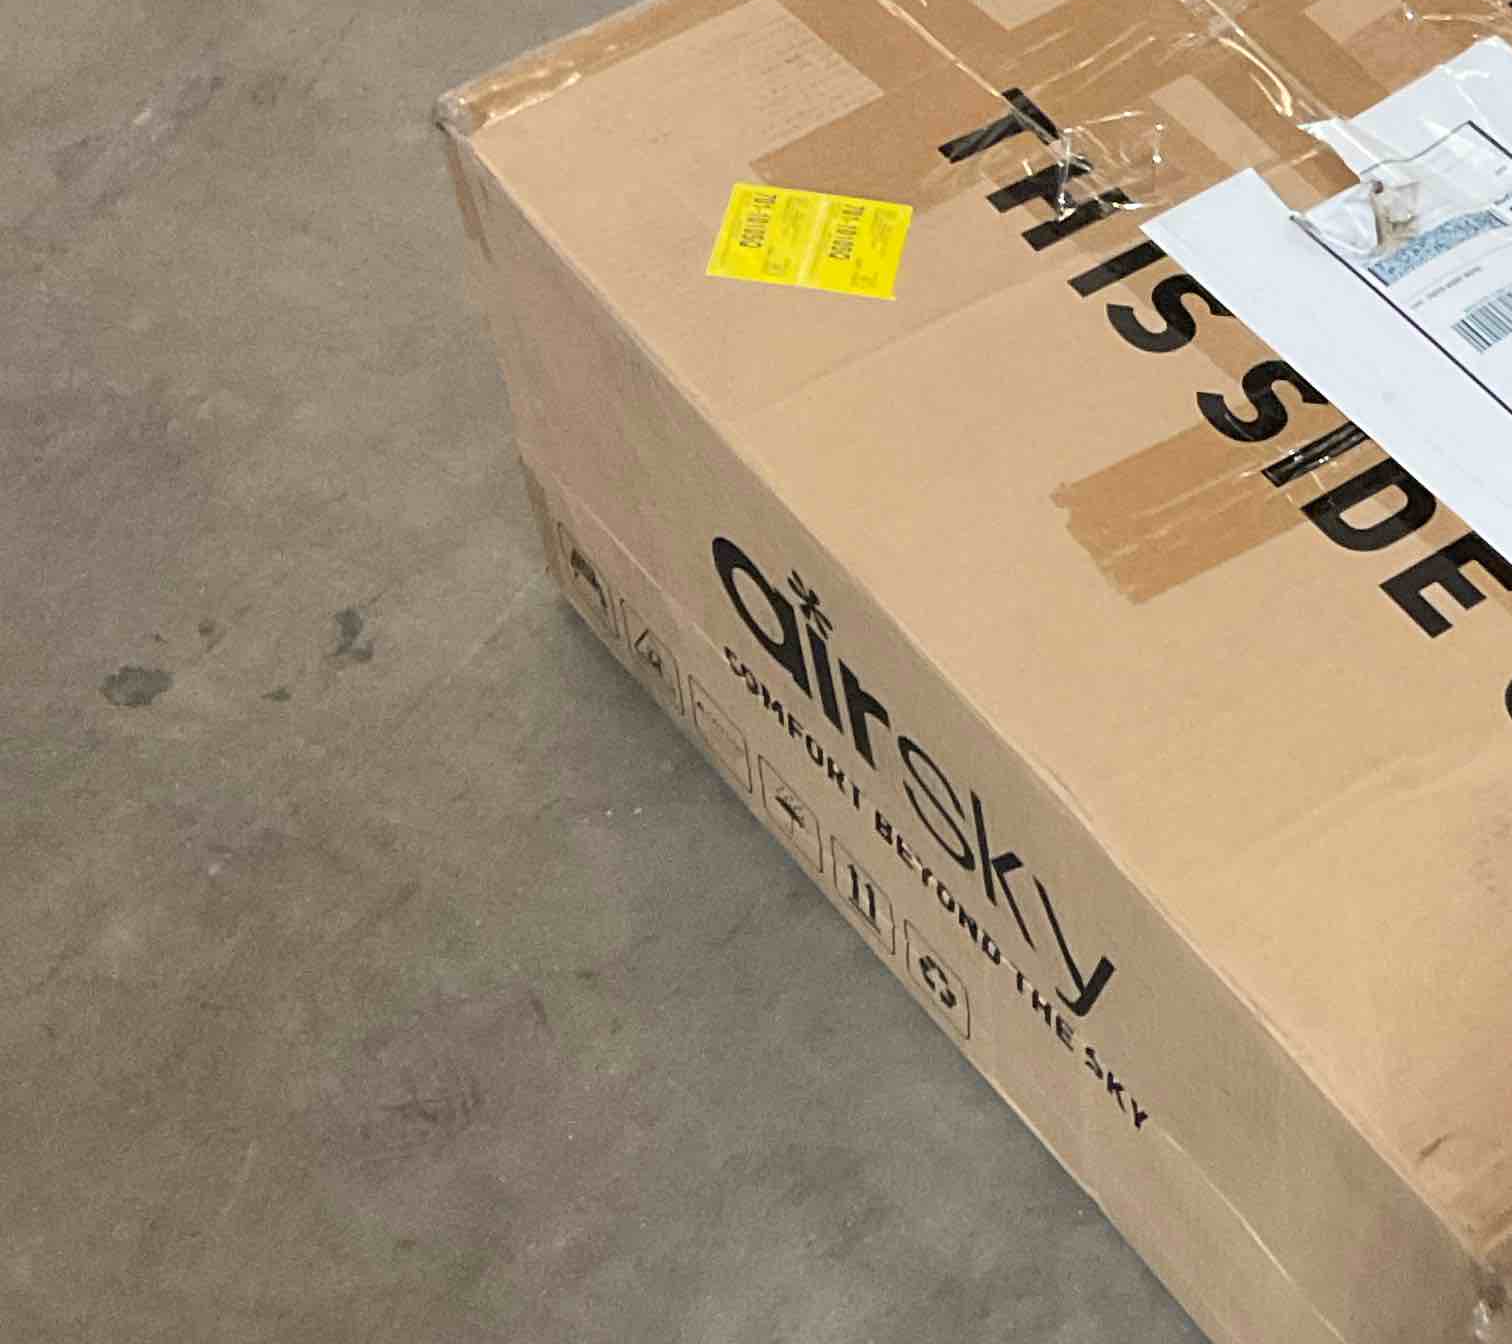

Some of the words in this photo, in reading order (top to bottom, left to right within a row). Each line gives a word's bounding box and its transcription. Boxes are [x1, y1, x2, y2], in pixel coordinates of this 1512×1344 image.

[937, 87, 1231, 354] THIS
[724, 646, 862, 811] COMFORT
[874, 811, 1002, 966] BEYOND
[1015, 973, 1075, 1053] THE
[1084, 1047, 1149, 1130] SKY
